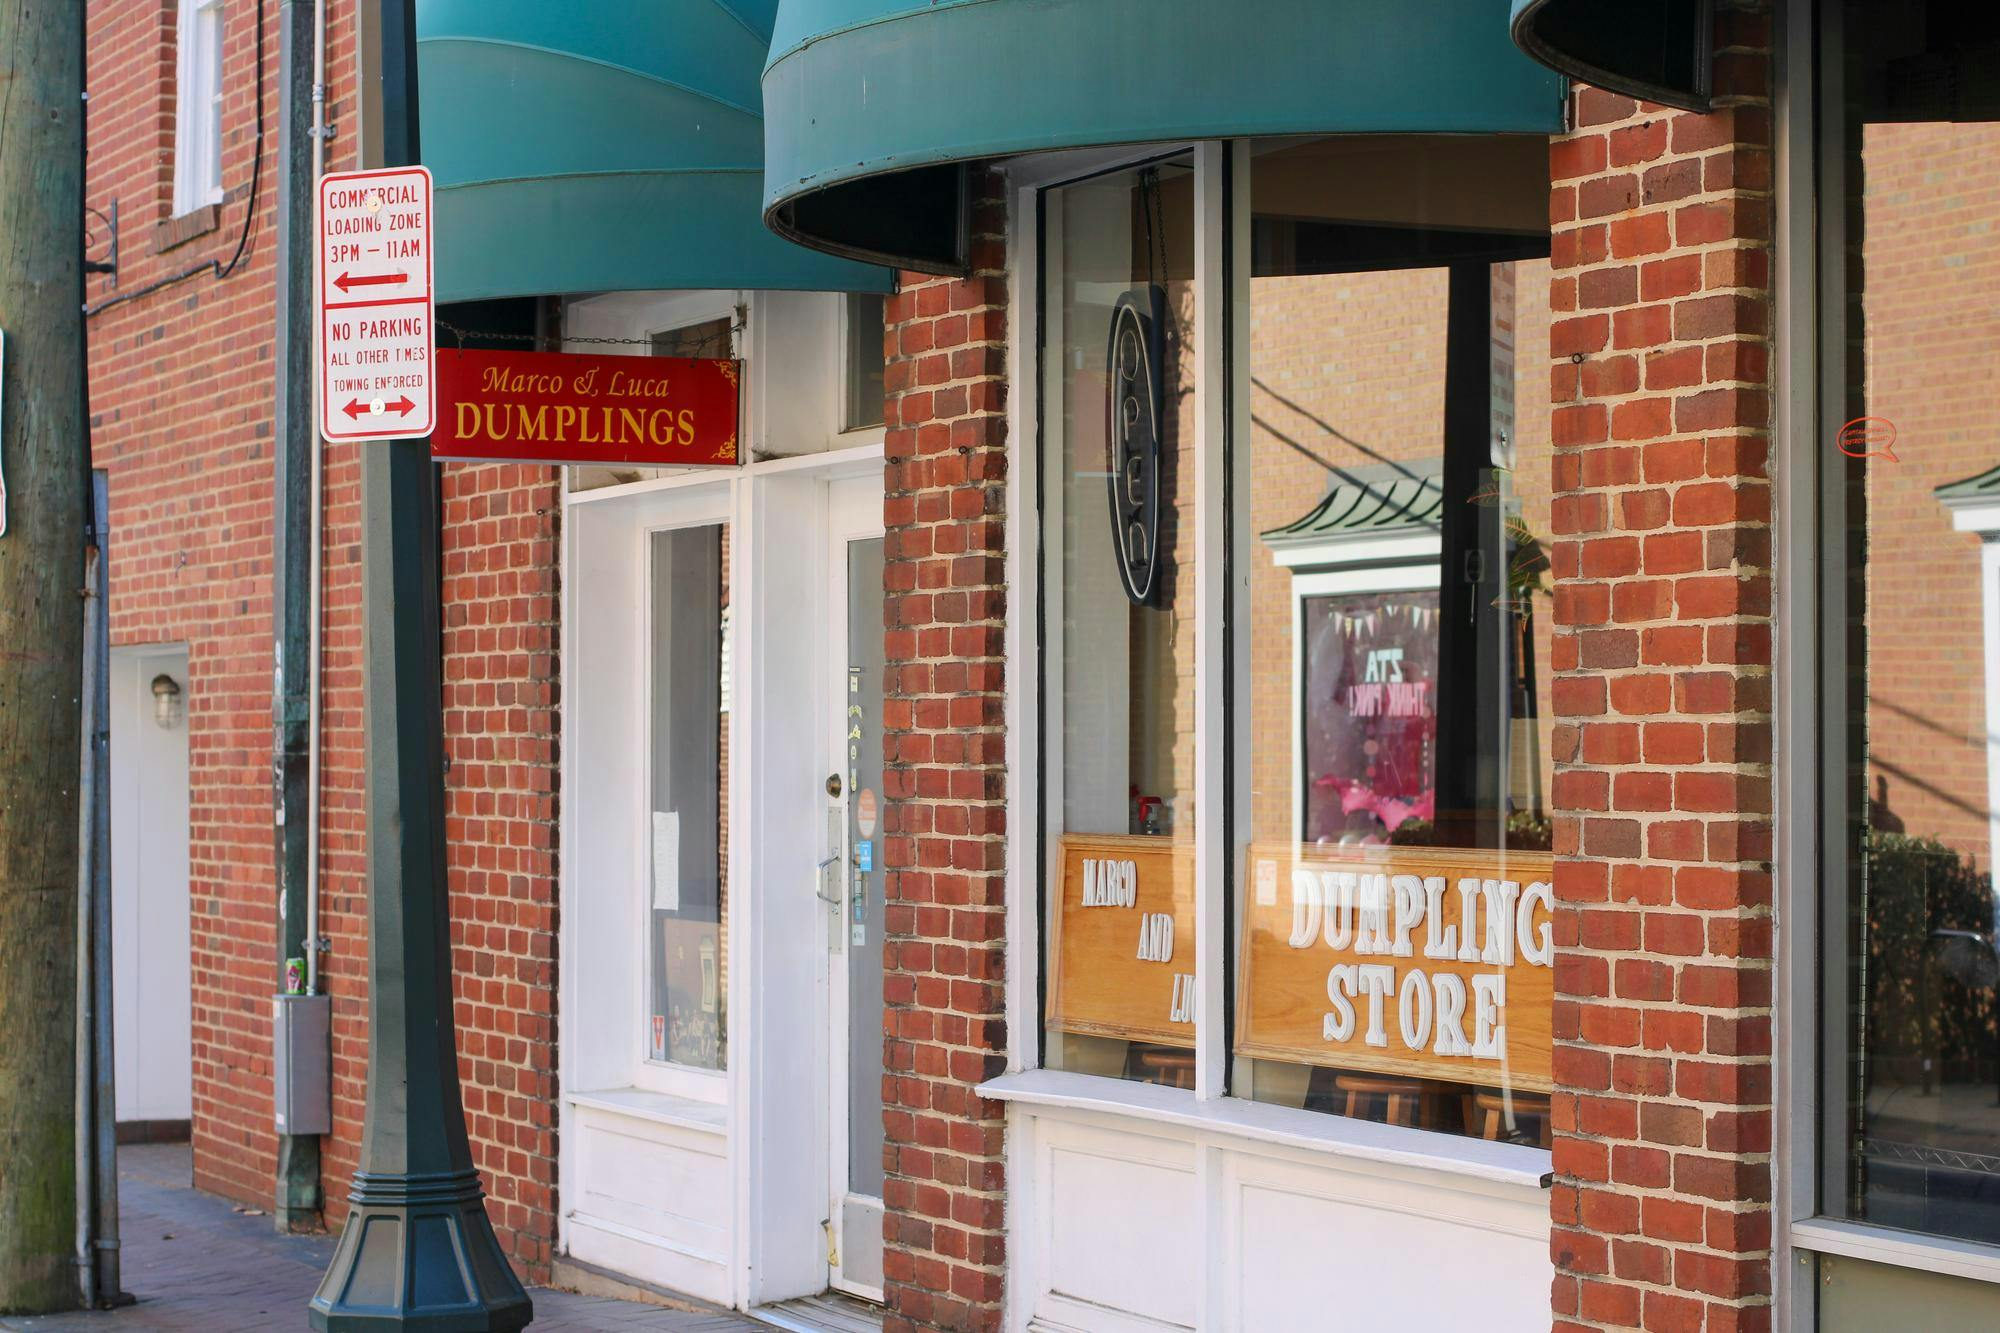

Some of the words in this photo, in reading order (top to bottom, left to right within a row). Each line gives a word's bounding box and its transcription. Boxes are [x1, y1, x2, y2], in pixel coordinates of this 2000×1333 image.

[329, 185, 418, 209] COMMRCIAL
[327, 216, 382, 236] LOADING
[389, 212, 422, 231] ZONE
[330, 243, 360, 263] 3PM
[387, 239, 420, 259] 11AM
[332, 322, 351, 342] NO
[360, 317, 422, 340] PARKING
[330, 352, 350, 366] ALL
[356, 349, 389, 364] OTHER
[396, 346, 425, 362] TMES
[334, 378, 369, 392] TOWING
[375, 374, 423, 390] ENFORCED
[481, 366, 563, 393] Marco
[573, 366, 600, 397] &
[606, 370, 669, 398] Luca
[454, 402, 695, 446] DUMPLINGS
[1082, 859, 1137, 909] MARCO
[1136, 912, 1174, 963] AND
[1323, 963, 1506, 1060] STORE
